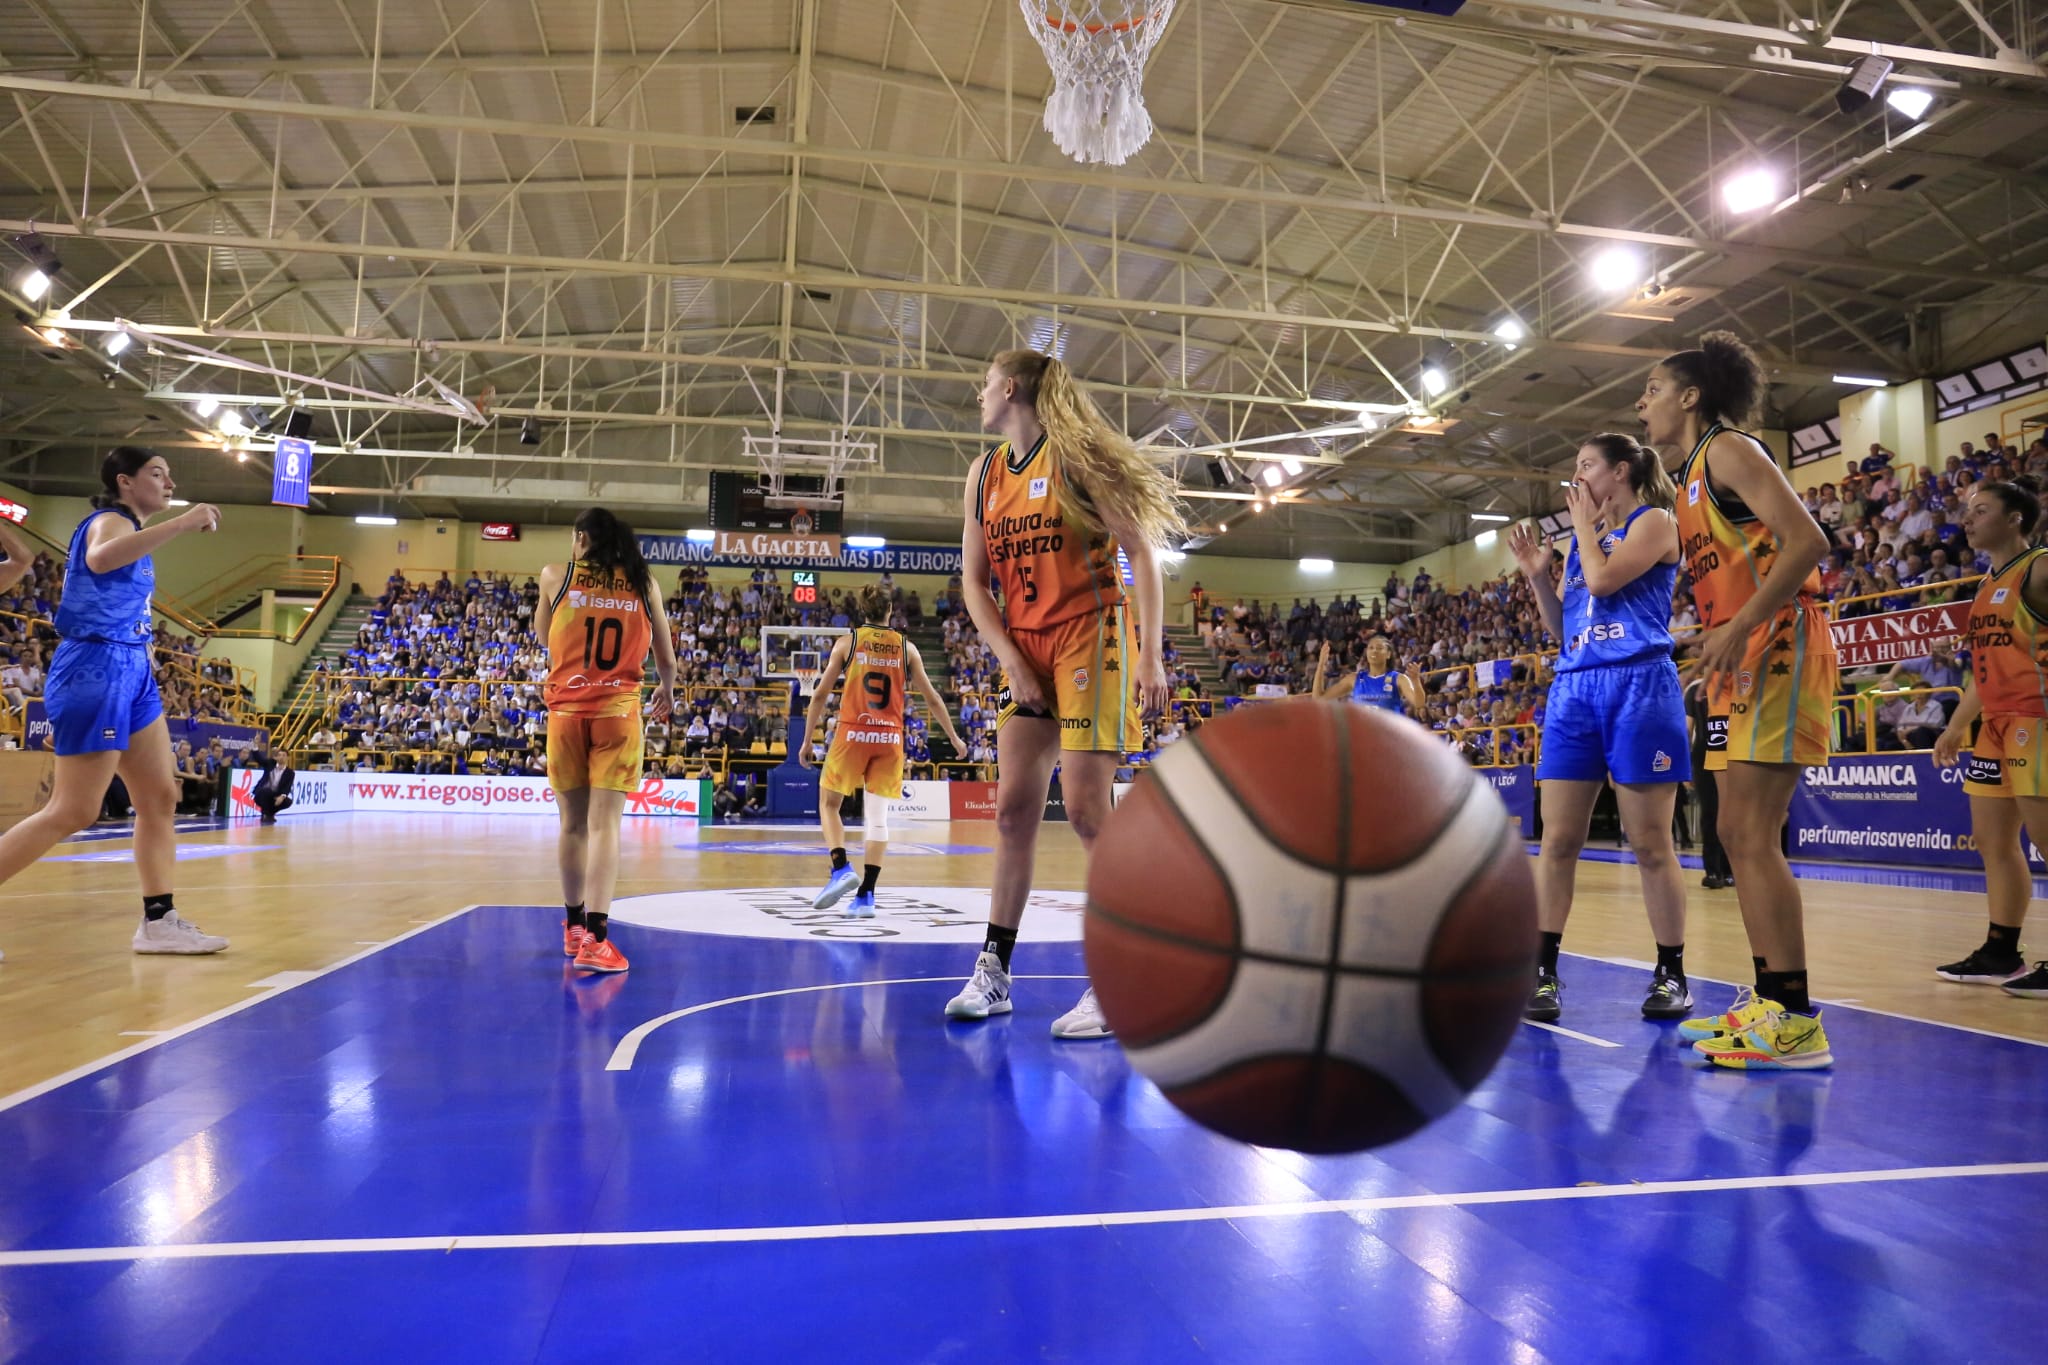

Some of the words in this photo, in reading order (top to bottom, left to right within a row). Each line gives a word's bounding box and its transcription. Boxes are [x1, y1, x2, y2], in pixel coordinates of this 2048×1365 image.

[286, 453, 299, 477] 8
[743, 487, 763, 495] LOCAL
[1044, 516, 1063, 528] del
[873, 550, 895, 568] DE
[1018, 567, 1037, 602] 15
[590, 594, 638, 612] isaval
[794, 587, 816, 603] 08
[1831, 609, 1957, 645] MANCA
[584, 617, 623, 671] 10
[869, 658, 901, 668] isaval
[1851, 648, 1873, 662] LA
[863, 672, 891, 710] 9
[1000, 690, 1011, 704] PU
[29, 718, 54, 738] perfu
[1061, 718, 1092, 729] mmo
[847, 731, 900, 745] PAMESA
[1804, 765, 1917, 786] SALAMANCA
[296, 783, 312, 804] 249
[314, 782, 327, 804] 815
[349, 778, 556, 807] www.riegosjose.e
[1799, 826, 1978, 850] perfumeriasavenida.co
